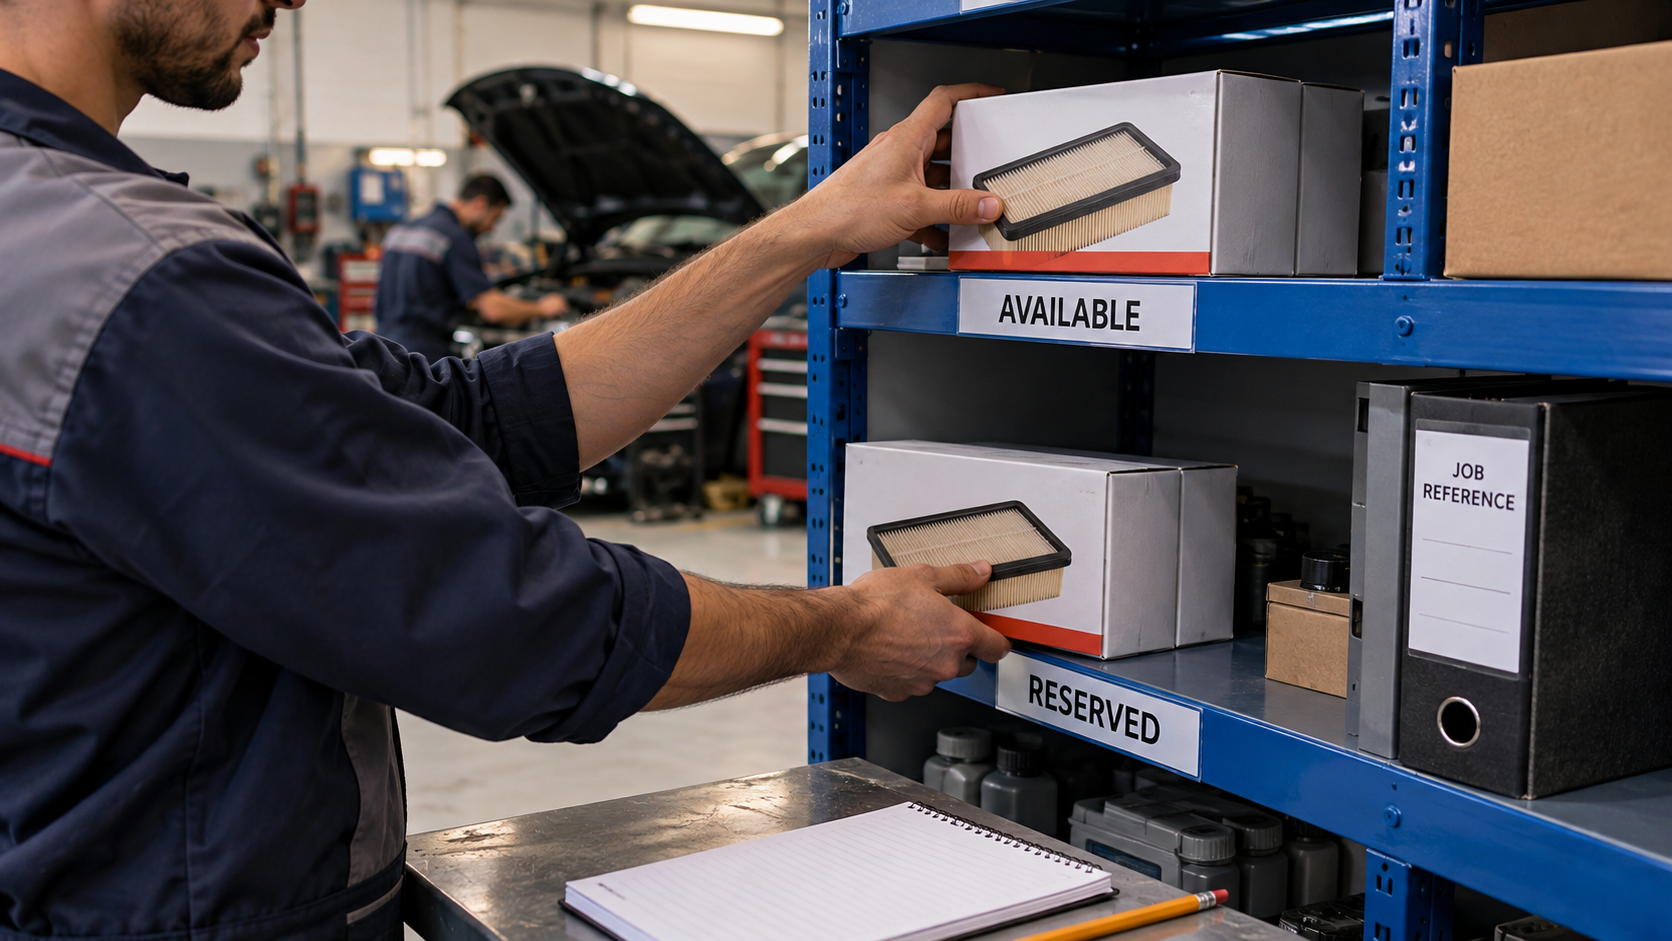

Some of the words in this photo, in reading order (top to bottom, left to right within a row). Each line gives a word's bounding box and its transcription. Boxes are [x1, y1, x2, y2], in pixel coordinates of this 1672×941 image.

[998, 294, 1141, 332] AVAILABLE
[1452, 461, 1485, 481] JOB
[1423, 482, 1516, 512] REFERENCE
[1028, 673, 1161, 745] RESERVED
